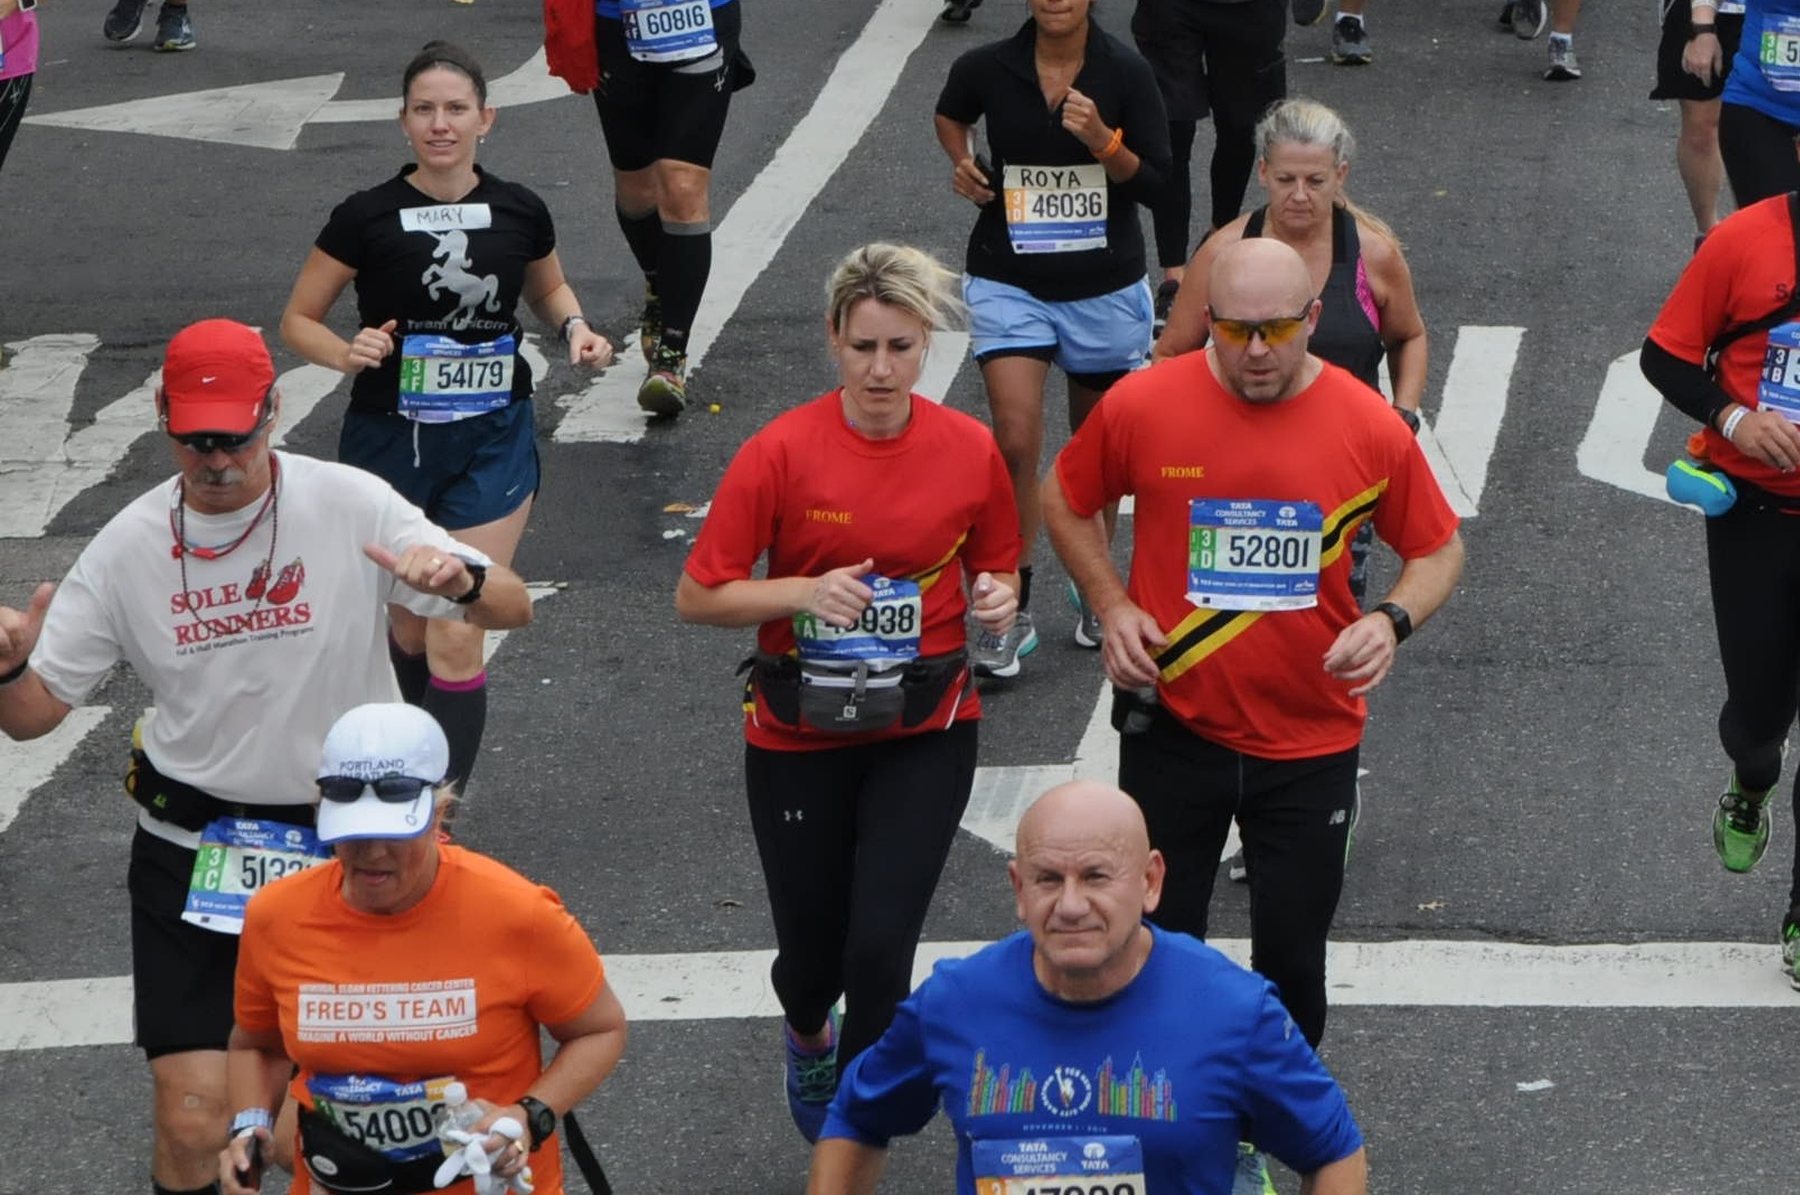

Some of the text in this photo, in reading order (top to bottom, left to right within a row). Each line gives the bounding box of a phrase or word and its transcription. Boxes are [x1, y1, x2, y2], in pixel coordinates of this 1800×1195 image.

[647, 4, 705, 36] 60816
[1020, 170, 1081, 188] ROYA
[1032, 192, 1103, 219] 46036
[416, 206, 463, 224] MARY
[406, 318, 448, 331] Team
[437, 361, 504, 389] 54179
[1161, 465, 1204, 479] FROME
[805, 508, 852, 525] FROME
[1214, 510, 1267, 518] CONSULTANCY
[1229, 537, 1309, 567] 52801
[170, 583, 242, 616] SOLE
[173, 601, 313, 647] RUNNERS
[213, 637, 248, 651] Marathon
[249, 632, 279, 647] Training
[280, 625, 315, 642] Programs
[340, 758, 404, 771] PORTLAND
[306, 998, 467, 1021] FRED'S TEAM
[349, 1030, 385, 1042] WORLD
[387, 1029, 434, 1041] WITHOUT
[436, 1026, 479, 1040] CANCER
[395, 1084, 424, 1097] TATA
[1018, 1142, 1048, 1153] TATA
[1001, 1153, 1067, 1165] CONSULTANCY
[1081, 1159, 1110, 1171] TATA
[1013, 1162, 1056, 1174] SERVICES
